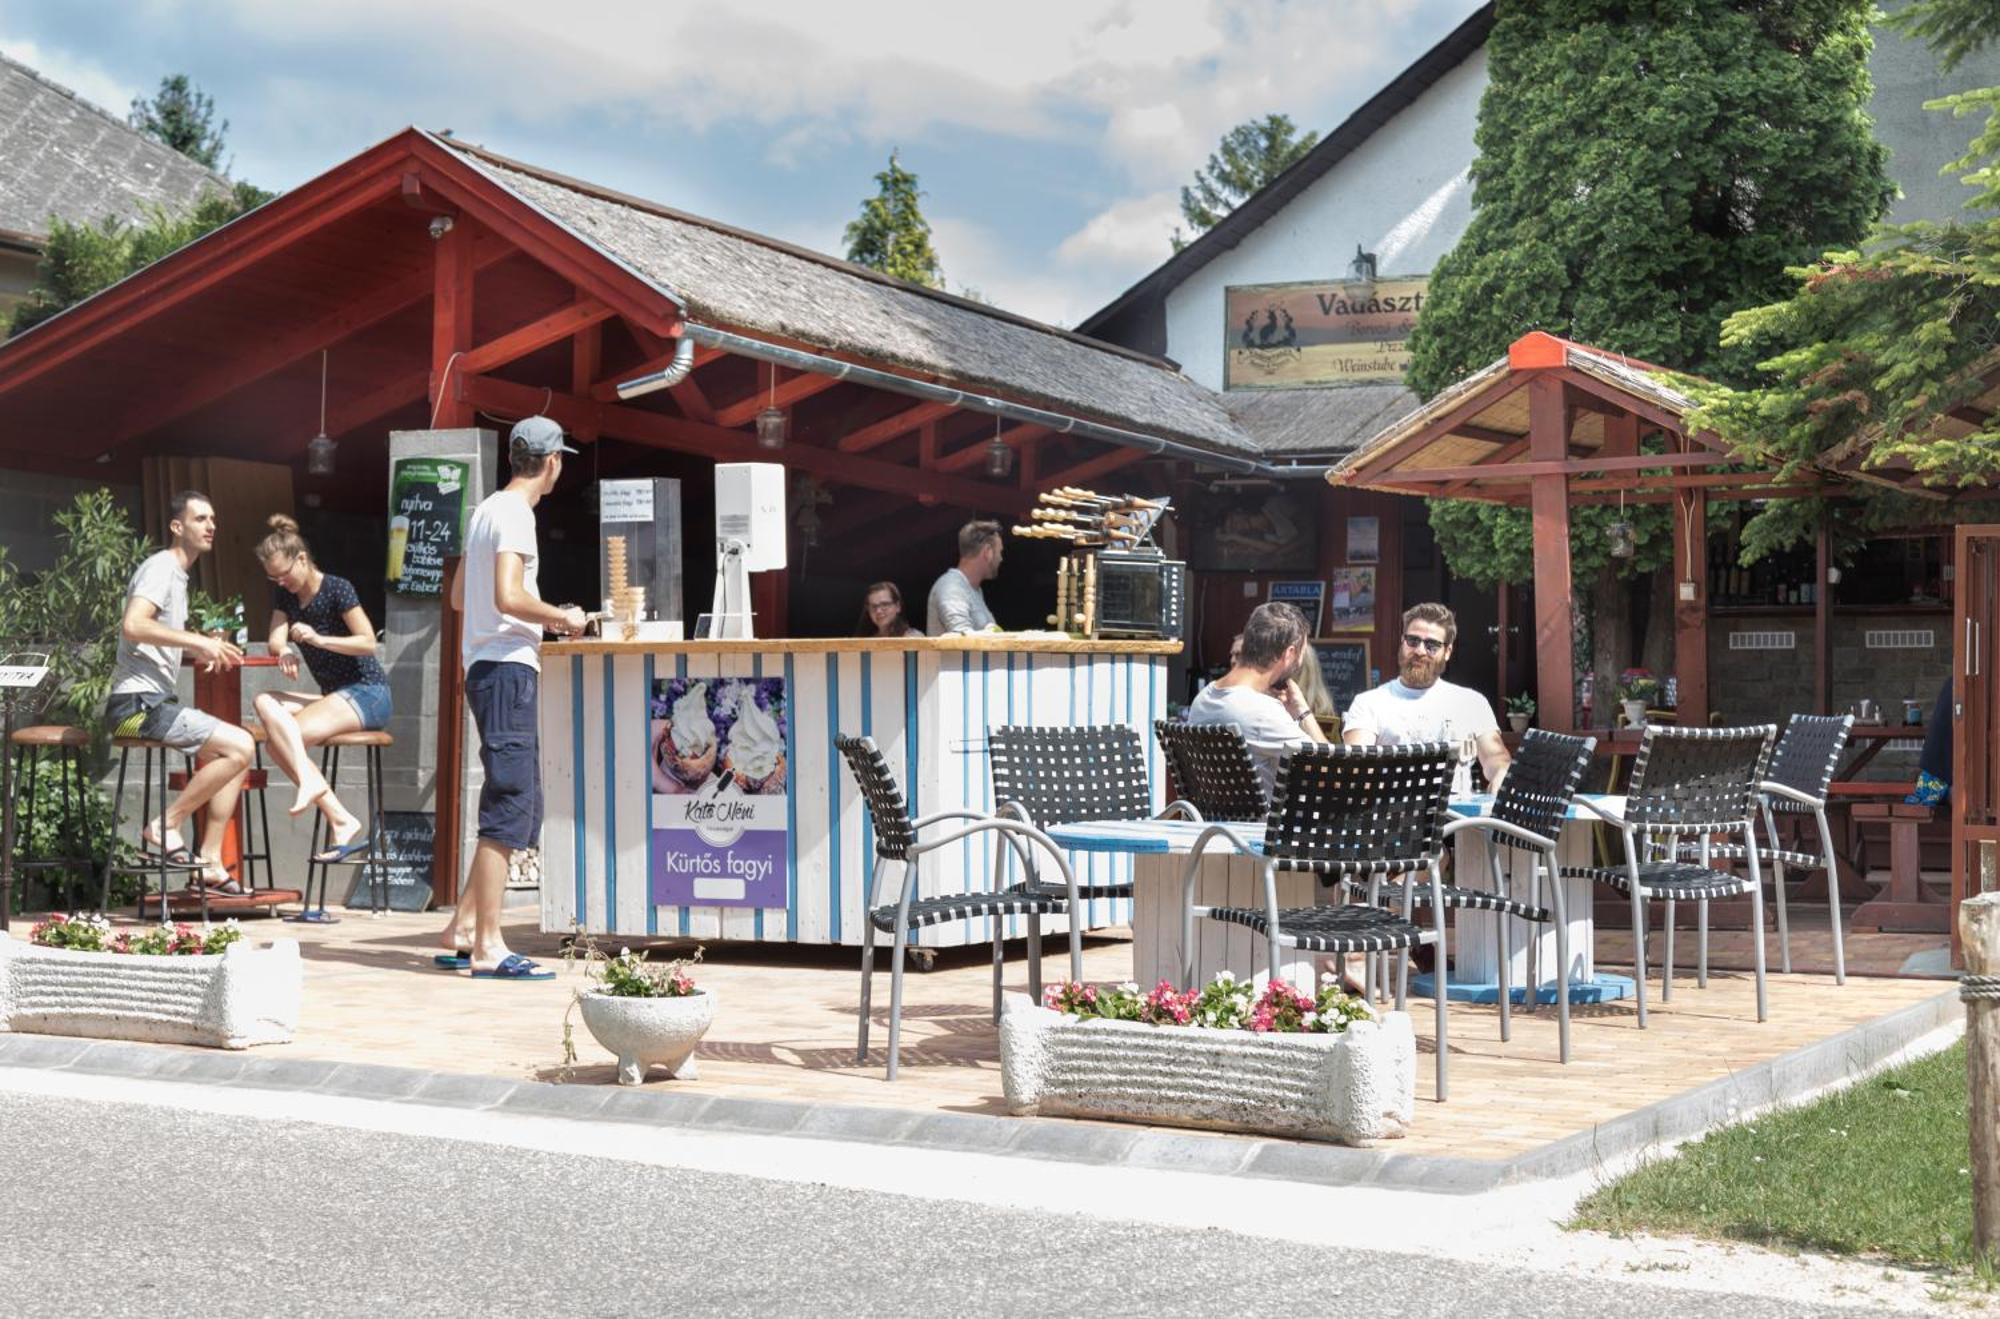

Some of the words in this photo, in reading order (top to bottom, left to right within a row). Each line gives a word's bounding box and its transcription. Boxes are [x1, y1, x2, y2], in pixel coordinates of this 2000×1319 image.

[401, 493, 433, 515] nyitva
[411, 519, 450, 542] 11-24
[666, 851, 721, 873] Kürtős
[726, 850, 773, 881] fagyi
